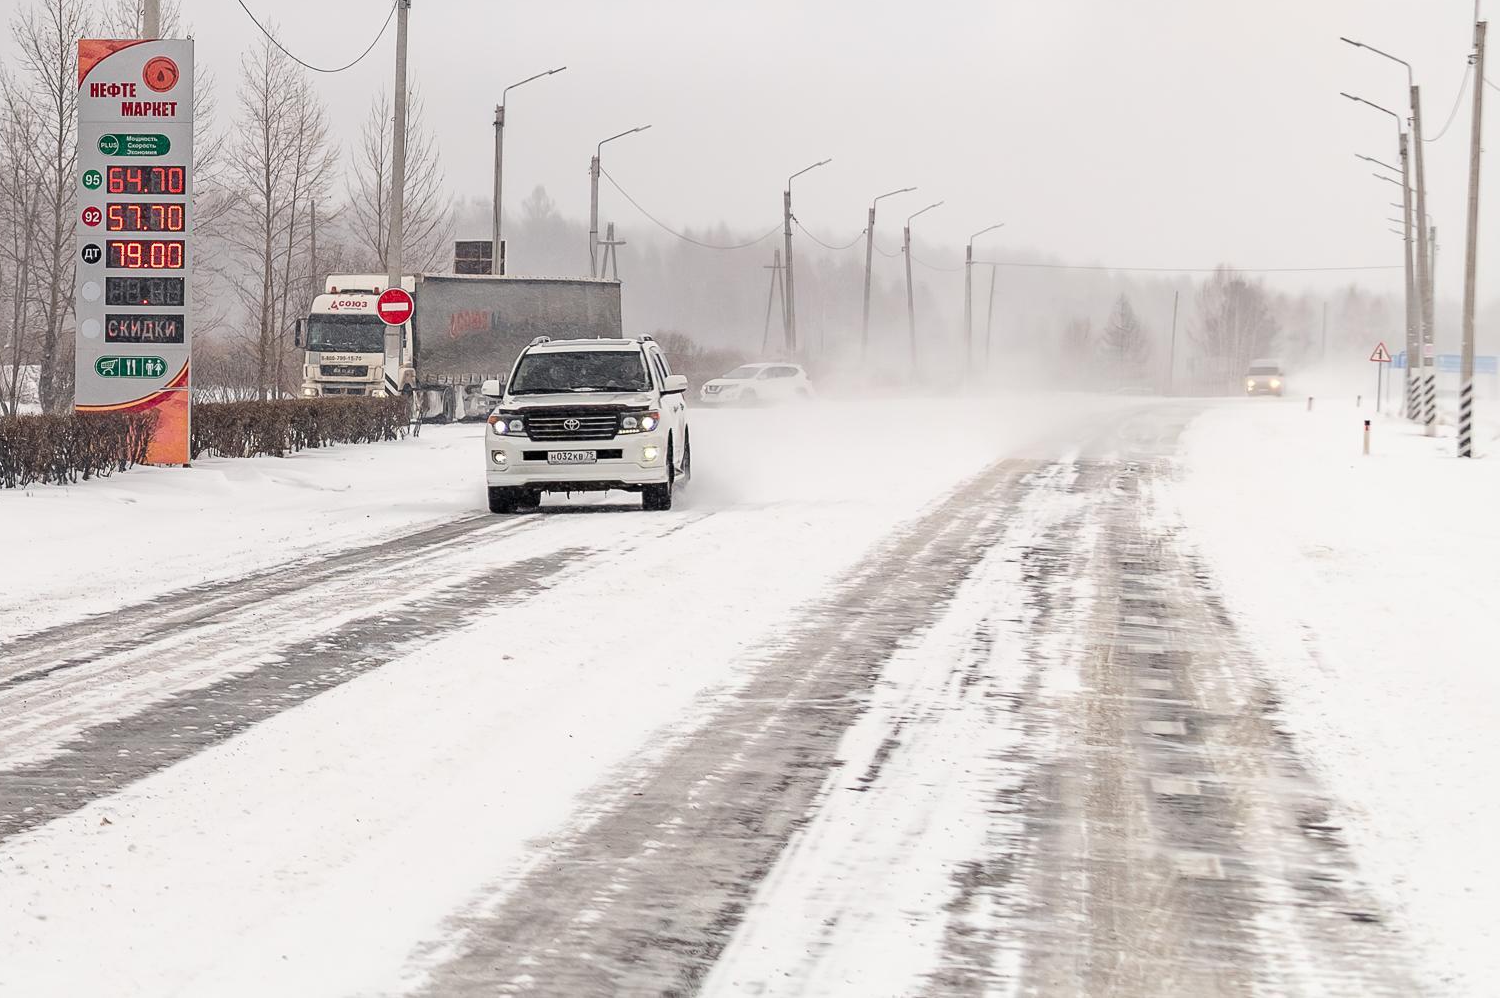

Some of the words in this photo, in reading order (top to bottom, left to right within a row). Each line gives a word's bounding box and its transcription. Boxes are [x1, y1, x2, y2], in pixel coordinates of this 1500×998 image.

[90, 83, 136, 98] НЕФТЕ
[121, 102, 177, 117] МАРКЕТ
[85, 175, 100, 186] 95
[109, 167, 183, 193] 64.70
[85, 212, 100, 223] 92
[109, 205, 182, 230] 57.70
[84, 249, 99, 259] ДТ
[112, 243, 182, 268] 79.00
[338, 300, 368, 308] СОЮЗ
[108, 320, 176, 339] СКИДКИ
